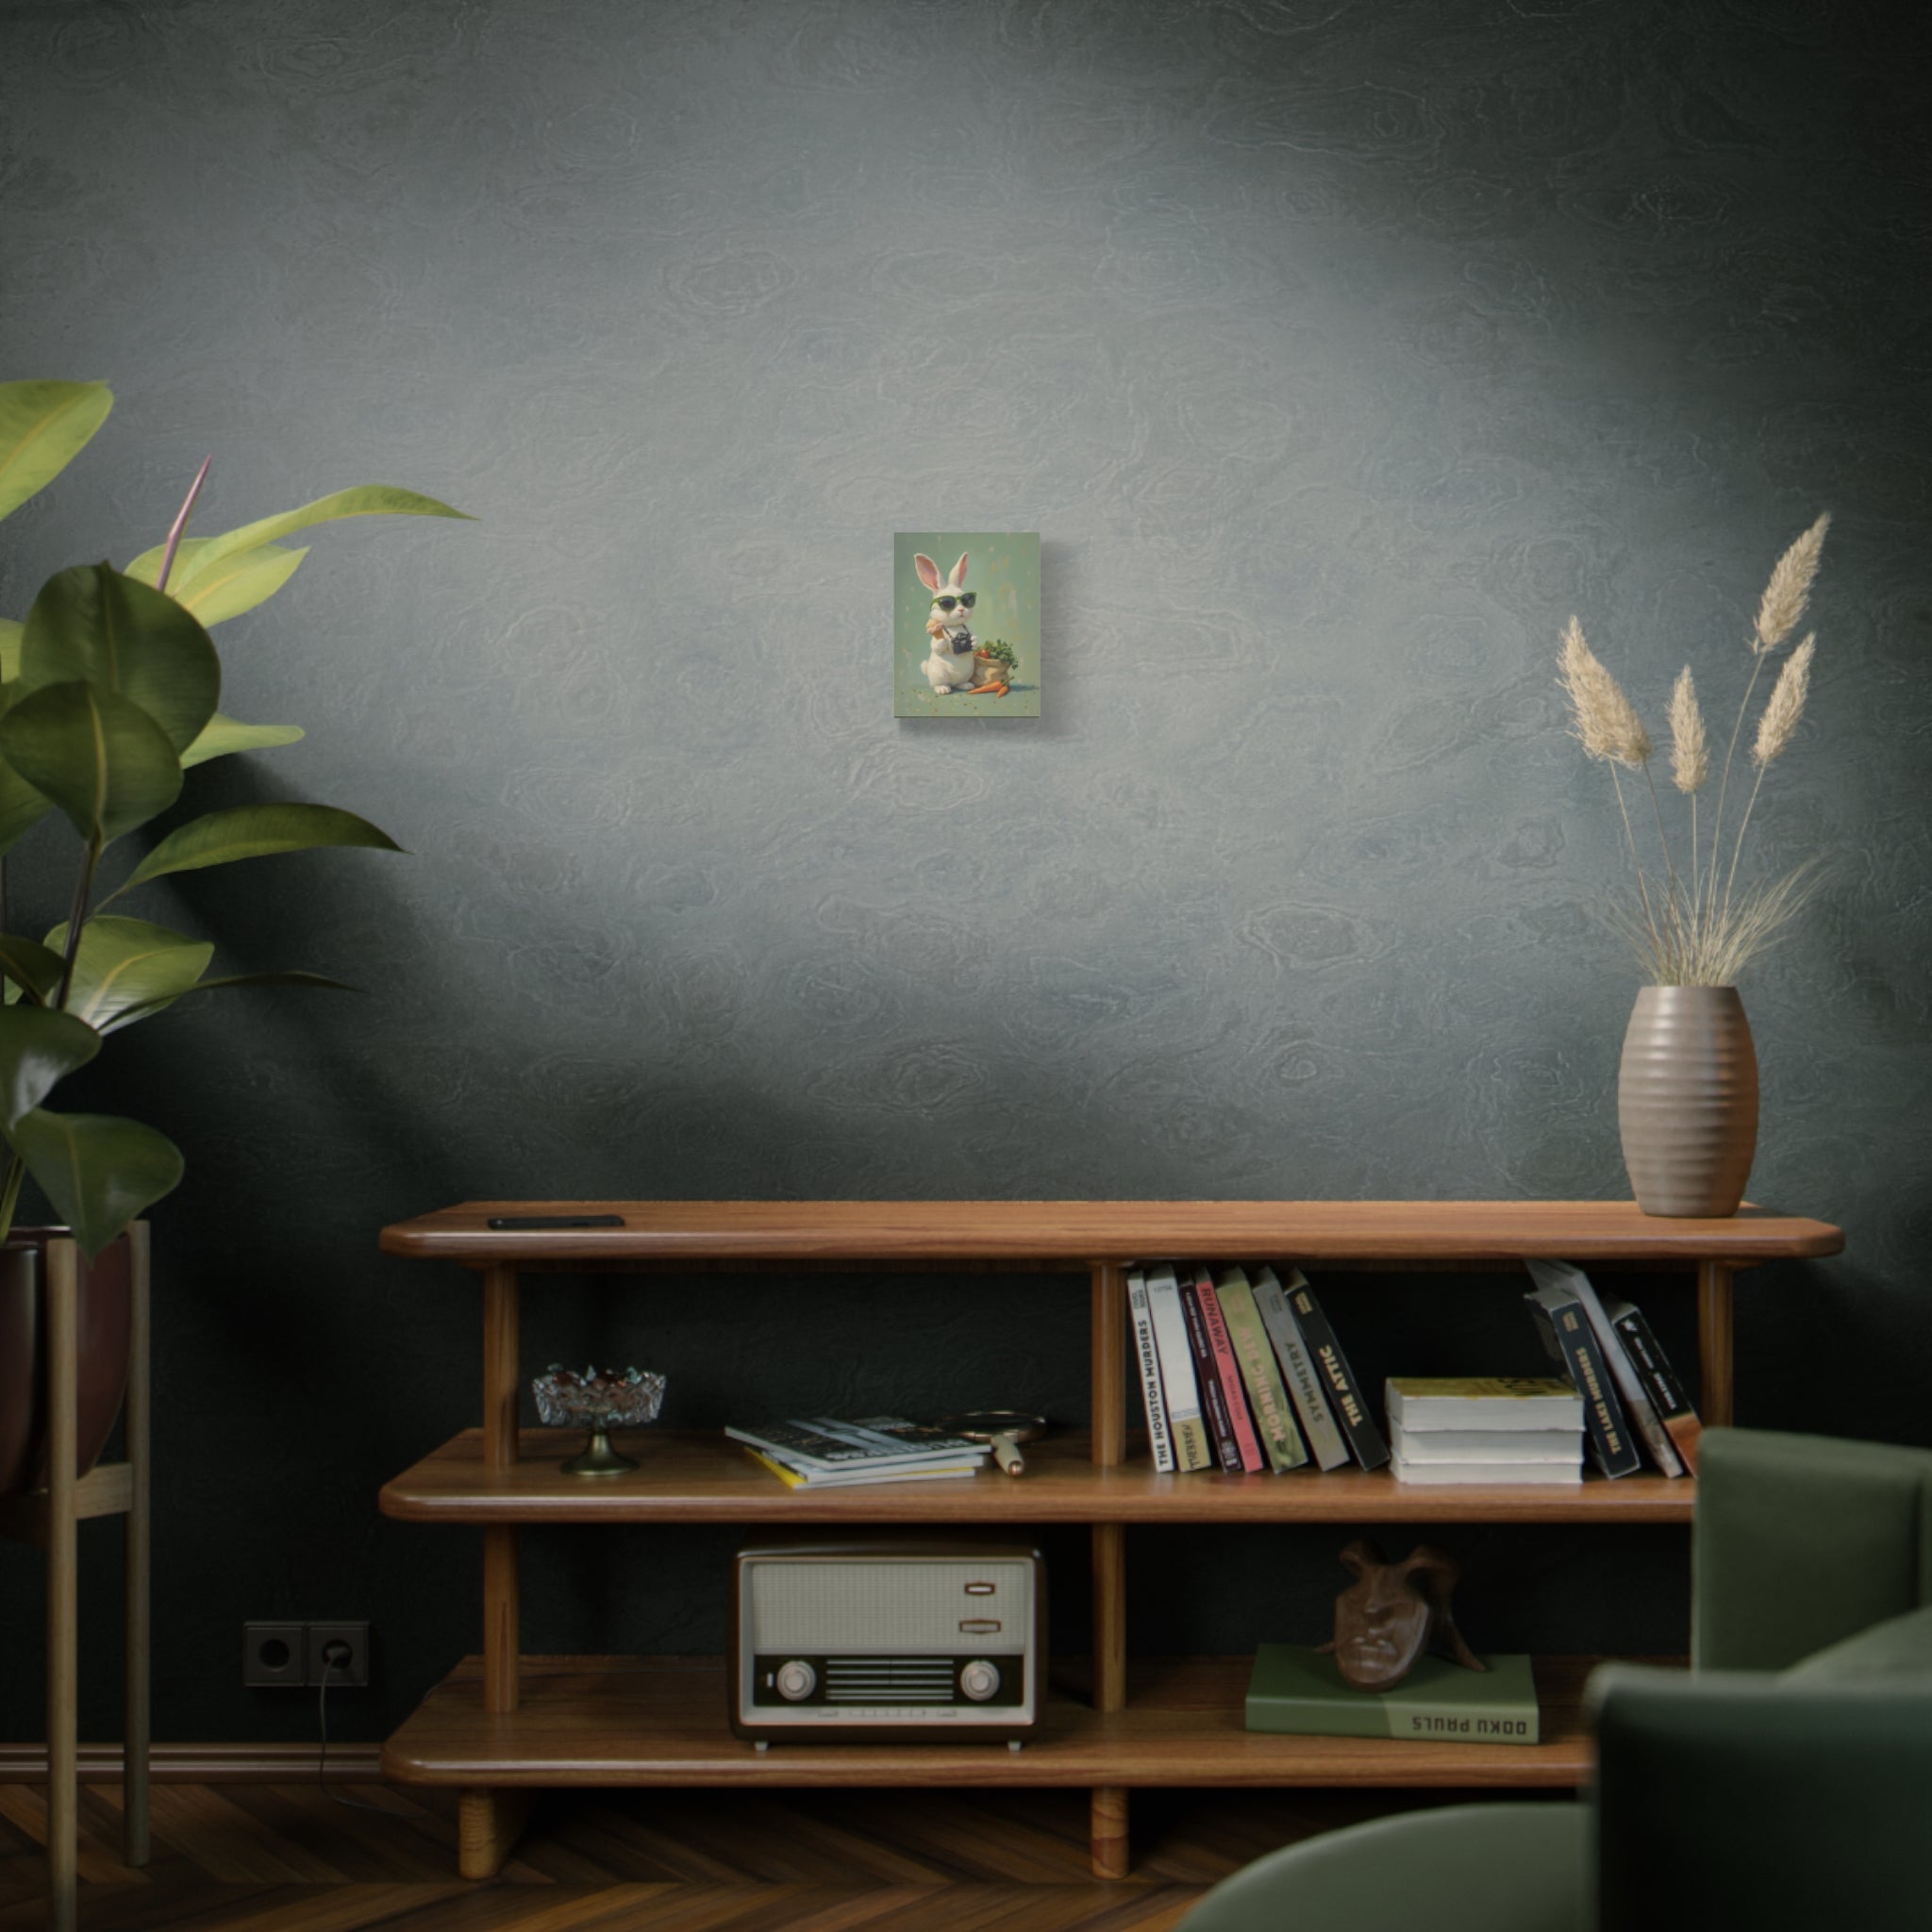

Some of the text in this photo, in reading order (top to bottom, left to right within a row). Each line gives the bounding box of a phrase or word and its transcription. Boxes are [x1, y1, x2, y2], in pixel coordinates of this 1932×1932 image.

[1201, 1287, 1228, 1356] RUNAWAY
[1138, 1319, 1169, 1466] THE HOUSTON MURDERS
[1238, 1325, 1287, 1442] MORNING DEW
[1285, 1341, 1324, 1423] SYMMETRY
[1319, 1344, 1363, 1426] THE ATTIC
[1575, 1346, 1623, 1456] THE LAKE MURDERS
[1412, 1717, 1470, 1732] PAULS
